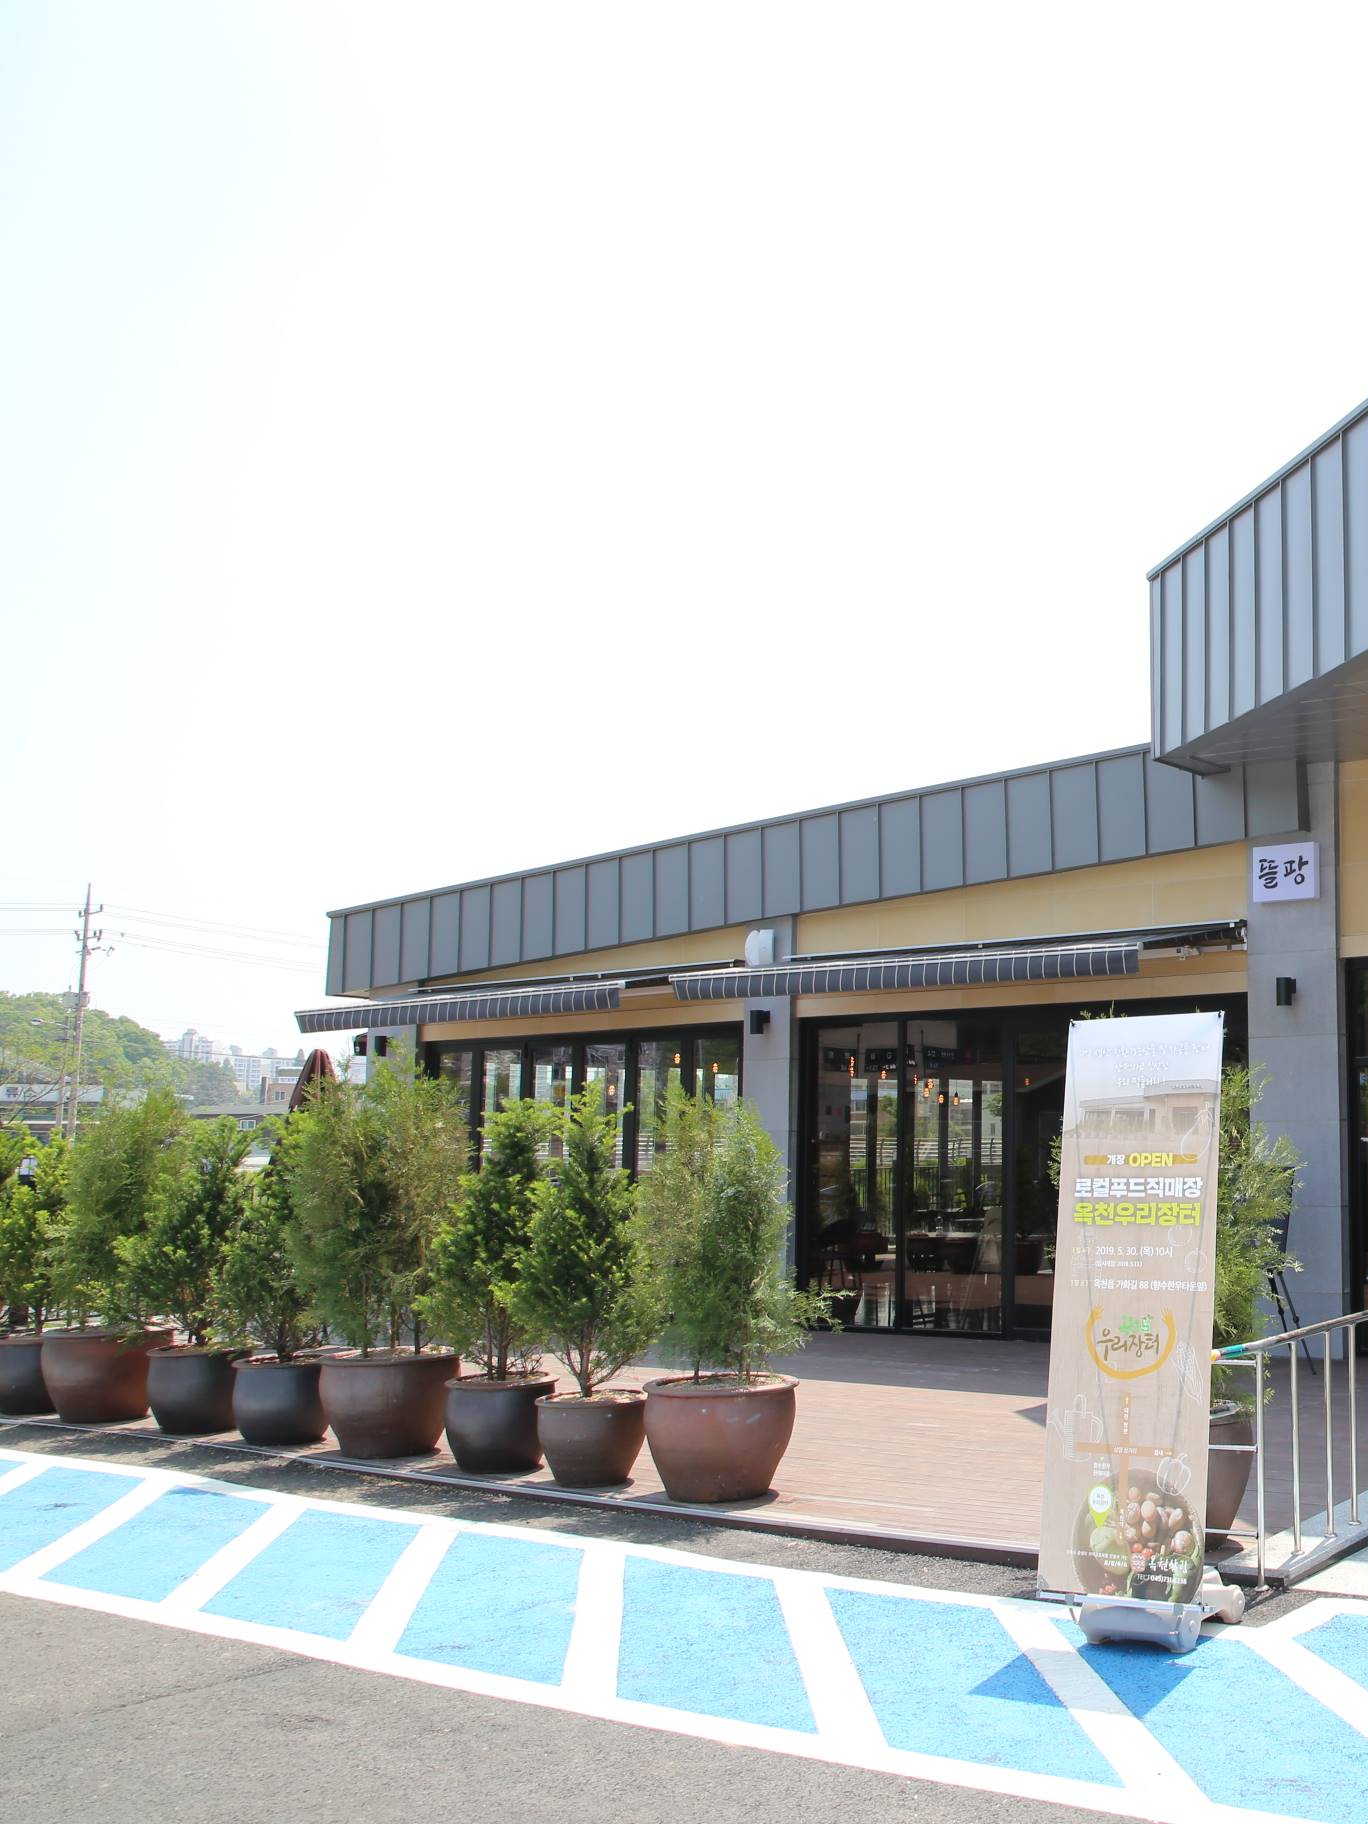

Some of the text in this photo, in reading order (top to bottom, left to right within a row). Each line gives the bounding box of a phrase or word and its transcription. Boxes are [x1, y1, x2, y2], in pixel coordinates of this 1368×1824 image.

[1106, 1152, 1174, 1168] 개장 OPEN
[1073, 1176, 1204, 1198] 로컬푸드직매장
[1072, 1201, 1201, 1227] 옥천우리장터
[1097, 1328, 1160, 1361] 우리장터
